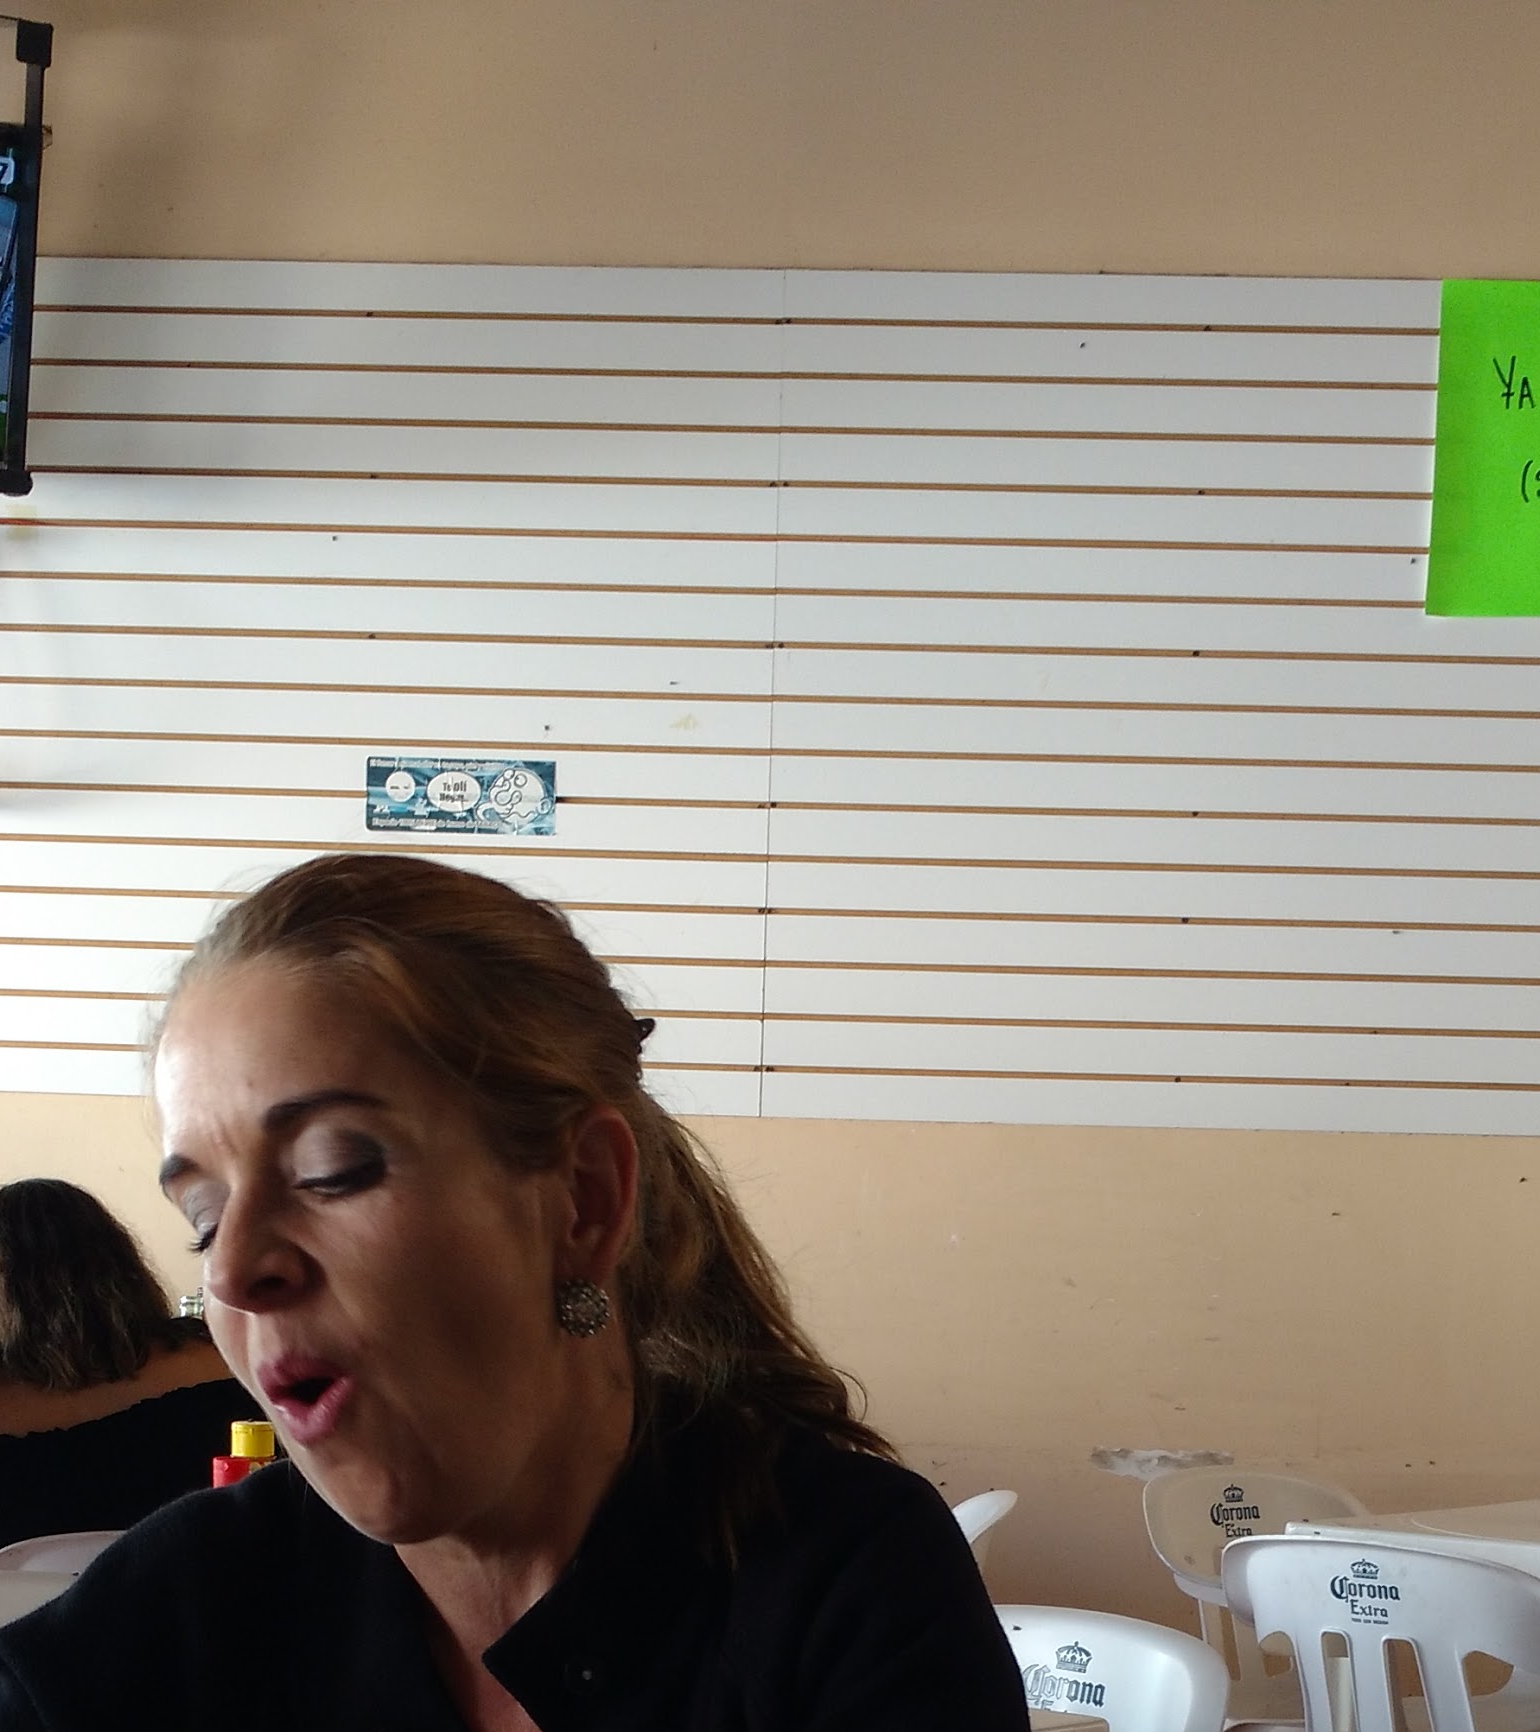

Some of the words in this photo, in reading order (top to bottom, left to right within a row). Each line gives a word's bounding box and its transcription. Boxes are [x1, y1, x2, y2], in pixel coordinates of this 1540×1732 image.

[1493, 355, 1536, 410] YA
[1210, 1503, 1261, 1528] Corona
[1225, 1523, 1253, 1538] Extra
[1330, 1575, 1401, 1603] Corona
[1350, 1599, 1389, 1618] Extra
[1021, 1663, 1106, 1708] Corona
